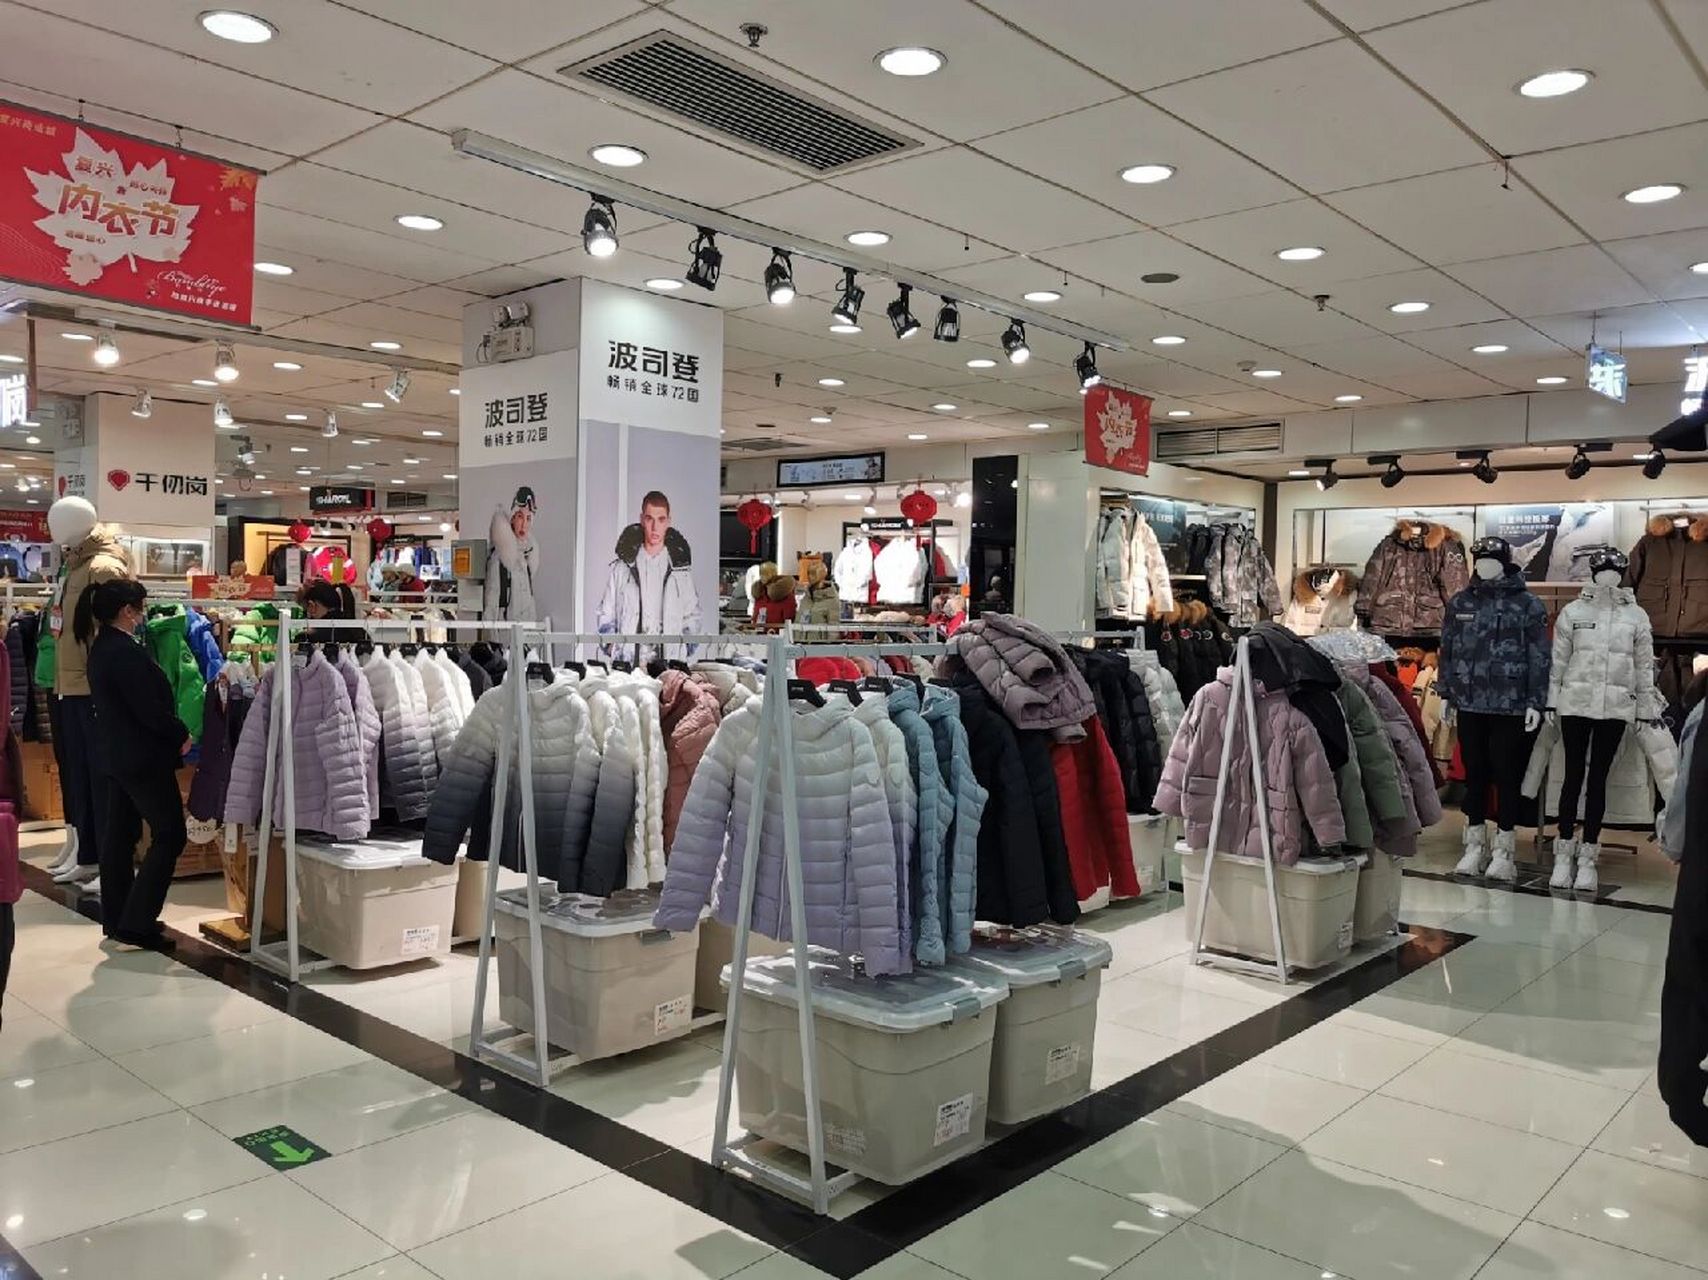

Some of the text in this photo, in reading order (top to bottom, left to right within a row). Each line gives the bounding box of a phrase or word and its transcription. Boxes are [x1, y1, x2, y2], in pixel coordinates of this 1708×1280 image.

[75, 155, 114, 178] 复兴
[58, 183, 179, 236] 内衣节
[607, 339, 700, 384] 波司登
[606, 374, 700, 404] 畅销全球72国
[484, 392, 549, 429] 波司登
[484, 426, 549, 448] 畅销全球72国
[135, 472, 208, 496] 千仞岗
